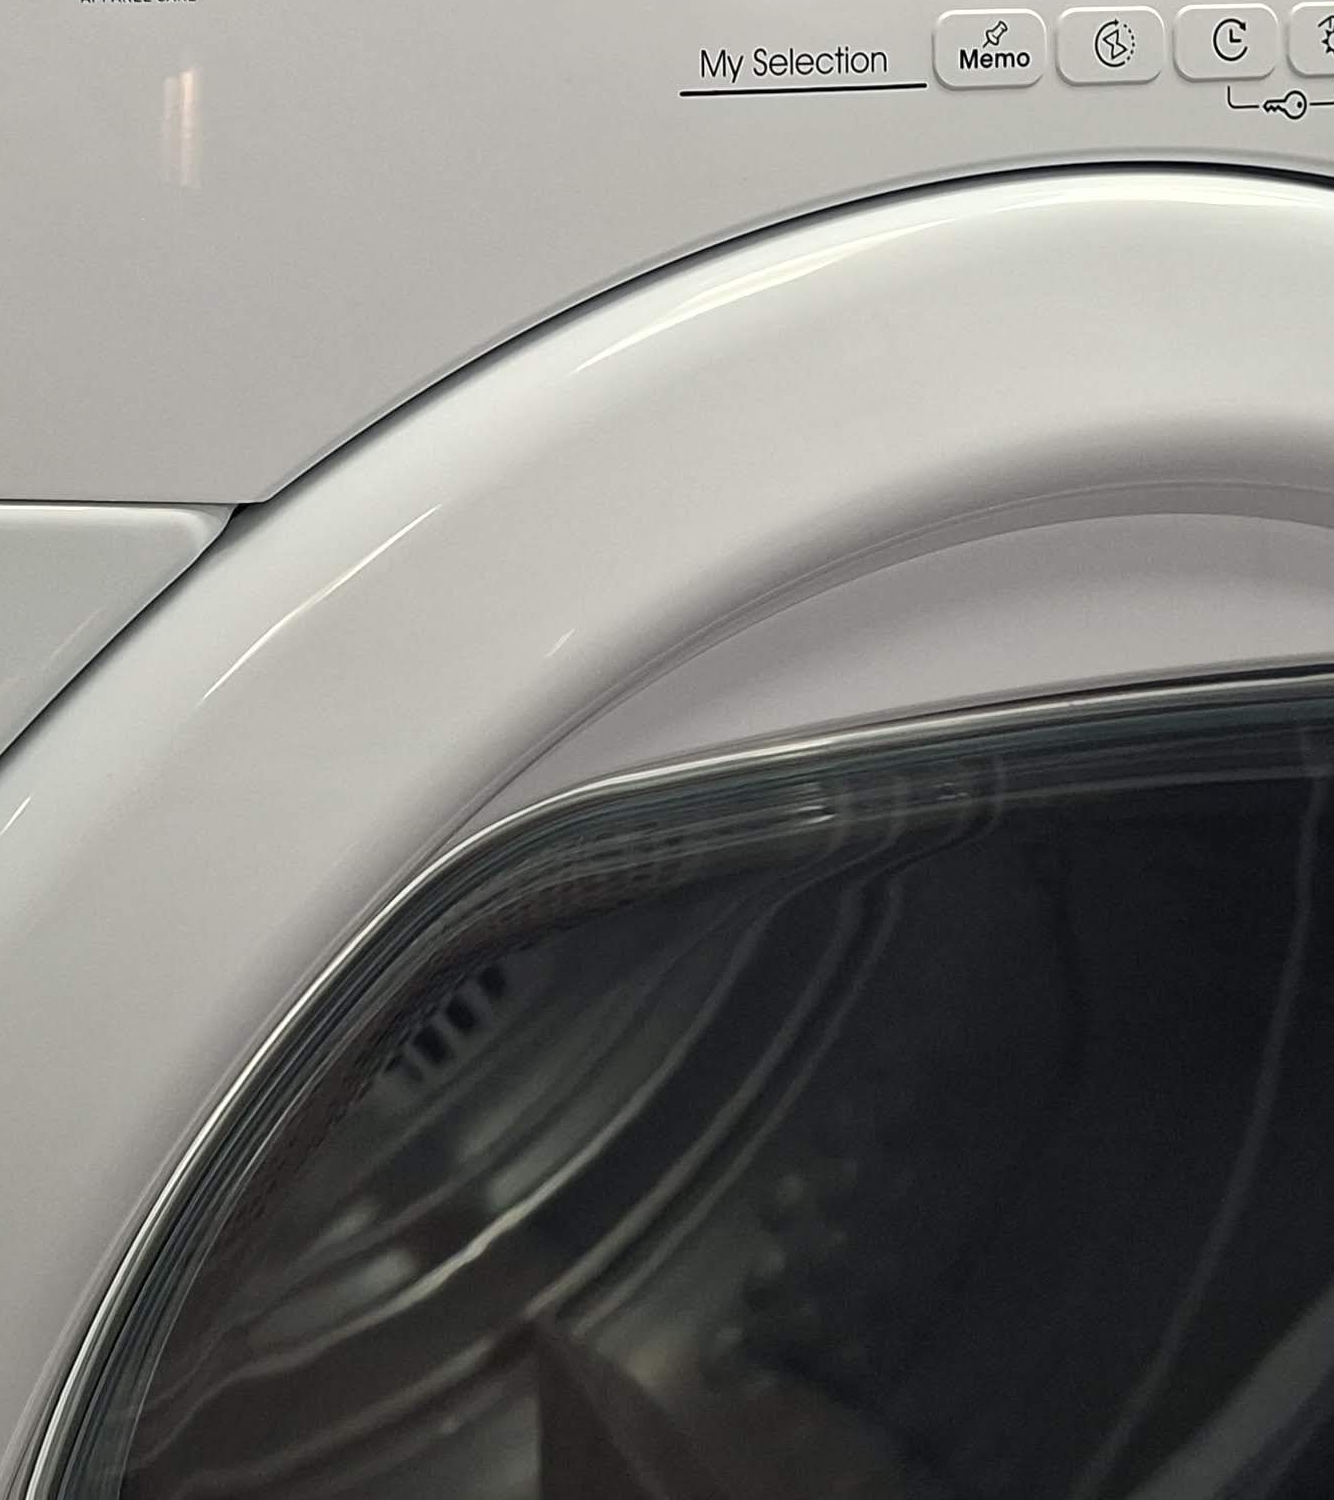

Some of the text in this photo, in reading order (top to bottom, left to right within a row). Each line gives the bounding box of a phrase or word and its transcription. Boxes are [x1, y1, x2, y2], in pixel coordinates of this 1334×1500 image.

[700, 46, 888, 83] My Selection
[959, 48, 1031, 71] Memo
